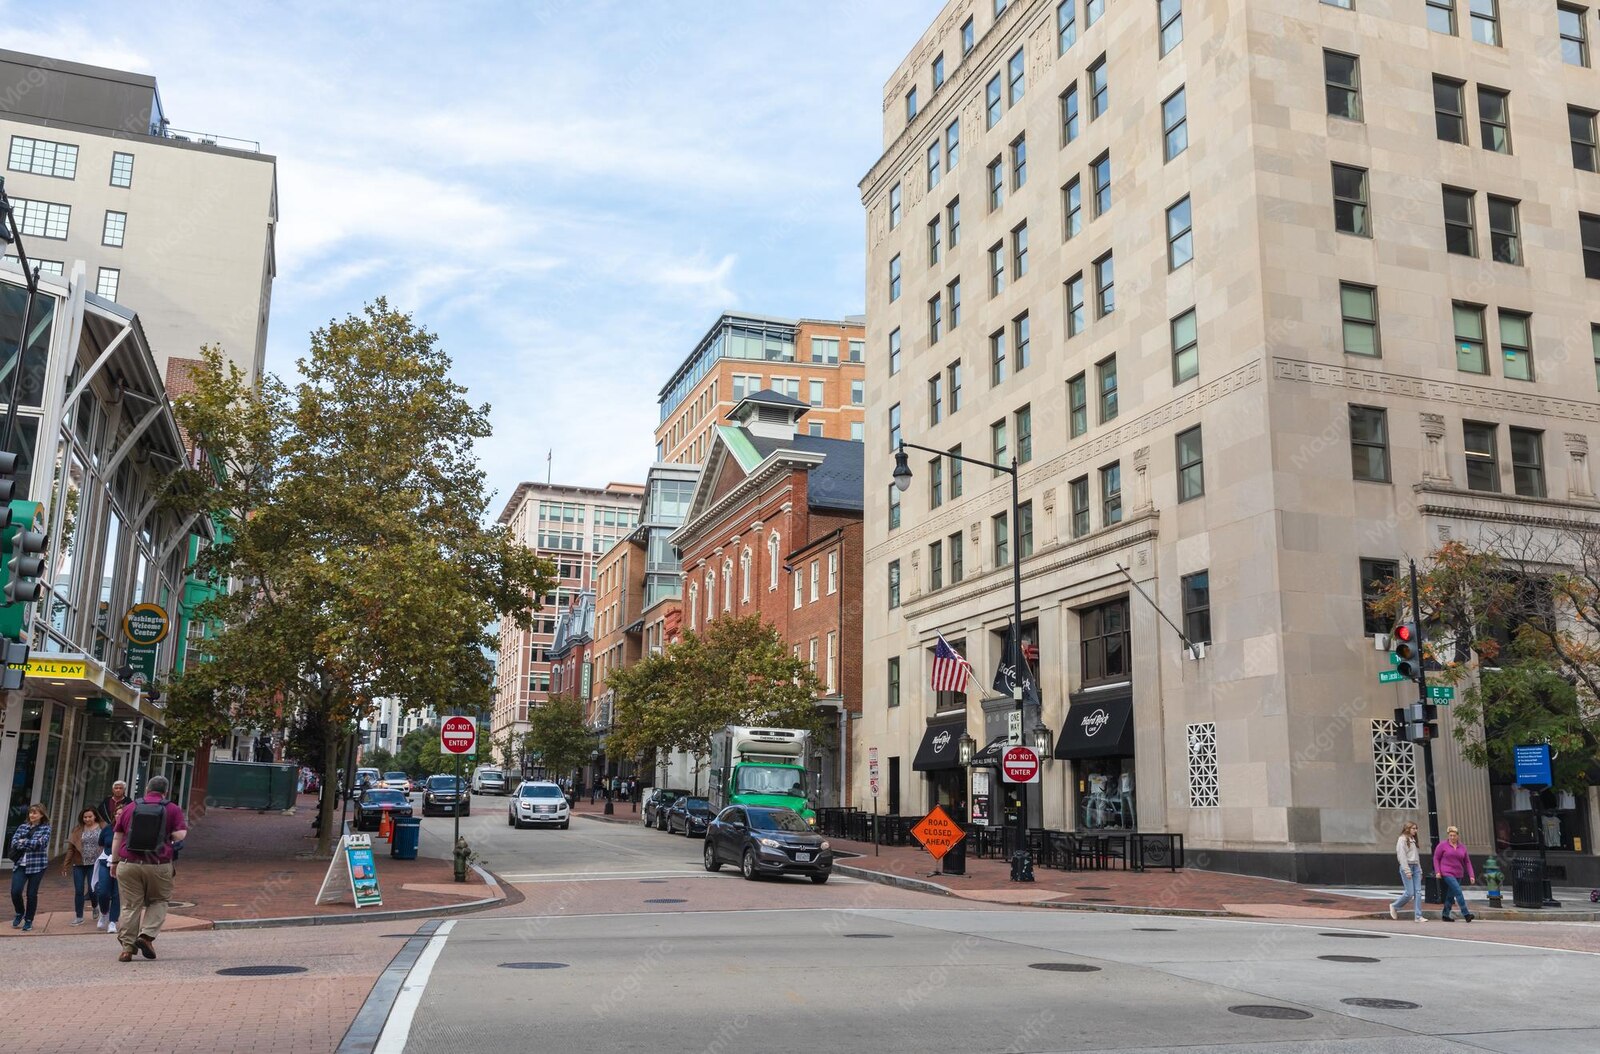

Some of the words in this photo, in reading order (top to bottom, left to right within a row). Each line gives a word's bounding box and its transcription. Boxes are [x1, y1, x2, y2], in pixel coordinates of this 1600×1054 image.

[127, 614, 167, 624] Washington
[132, 622, 161, 630] Welcome
[134, 629, 157, 637] Center
[36, 664, 57, 673] ALL
[60, 666, 83, 674] DAY
[1433, 688, 1440, 697] E
[1010, 713, 1020, 722] ONE
[1010, 723, 1020, 731] WAY
[449, 739, 468, 747] ENTER
[929, 819, 948, 827] ROAD
[924, 829, 951, 837] CLOSED
[926, 838, 950, 846] AHEAD
